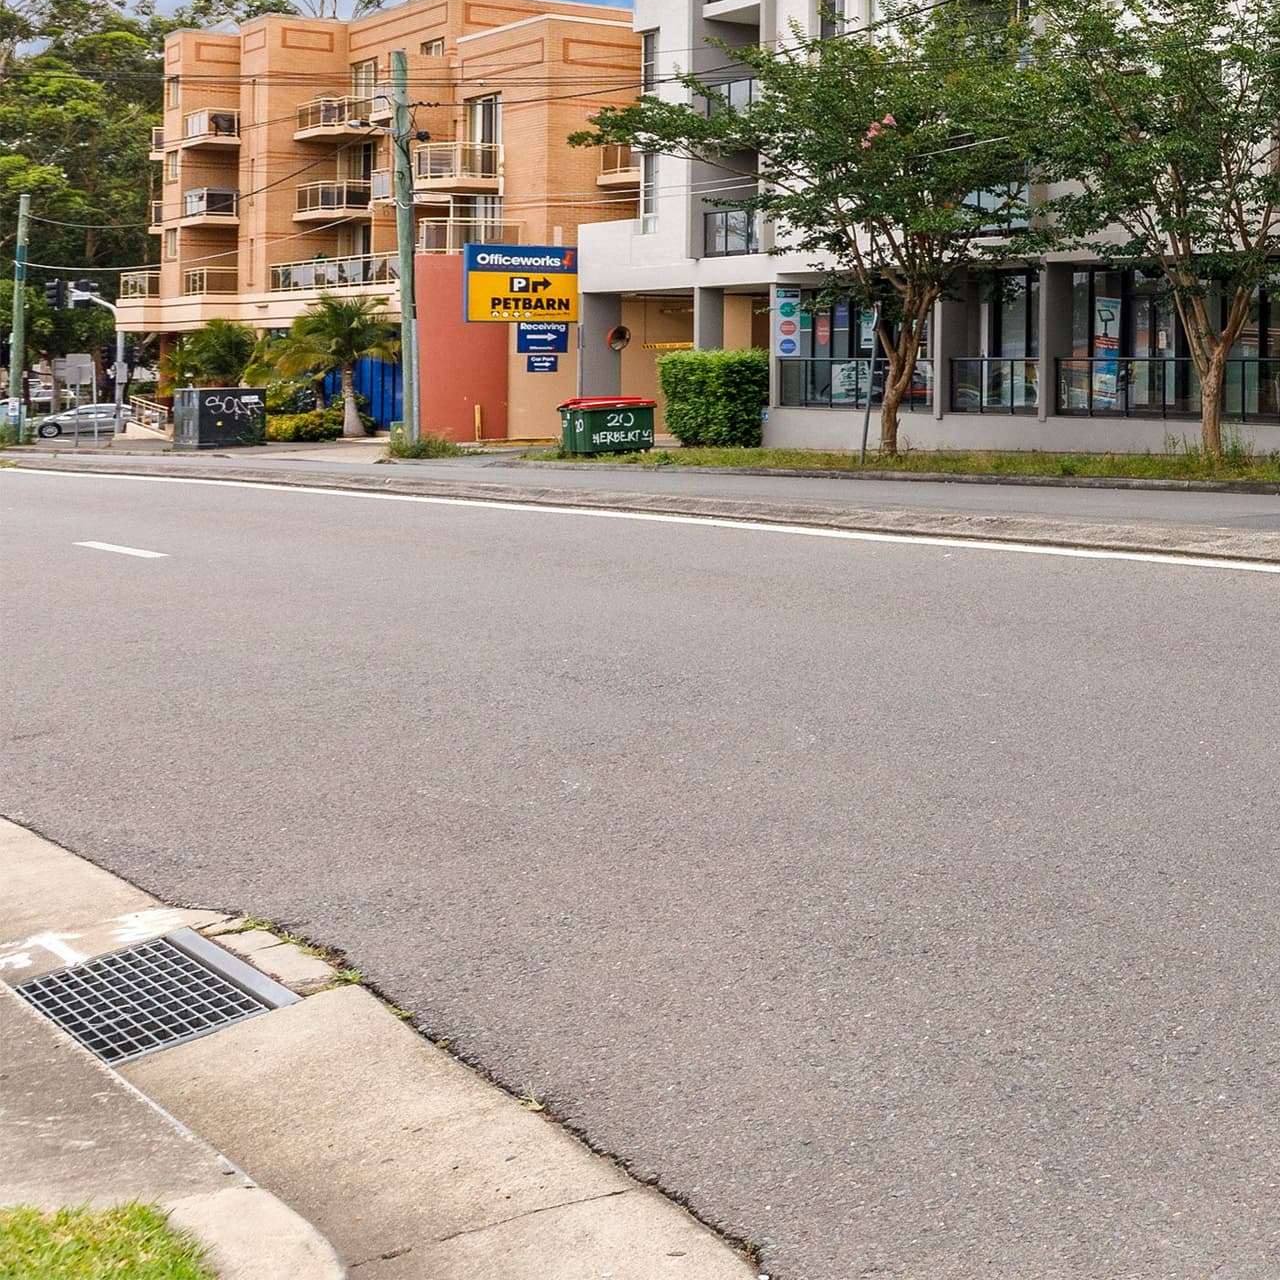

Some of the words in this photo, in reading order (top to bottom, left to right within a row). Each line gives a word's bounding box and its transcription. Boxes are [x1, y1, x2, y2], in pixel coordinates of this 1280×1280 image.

[476, 253, 561, 267] Officeworks
[513, 278, 527, 291] P
[491, 297, 570, 310] PETBARN
[520, 322, 566, 332] Receiving
